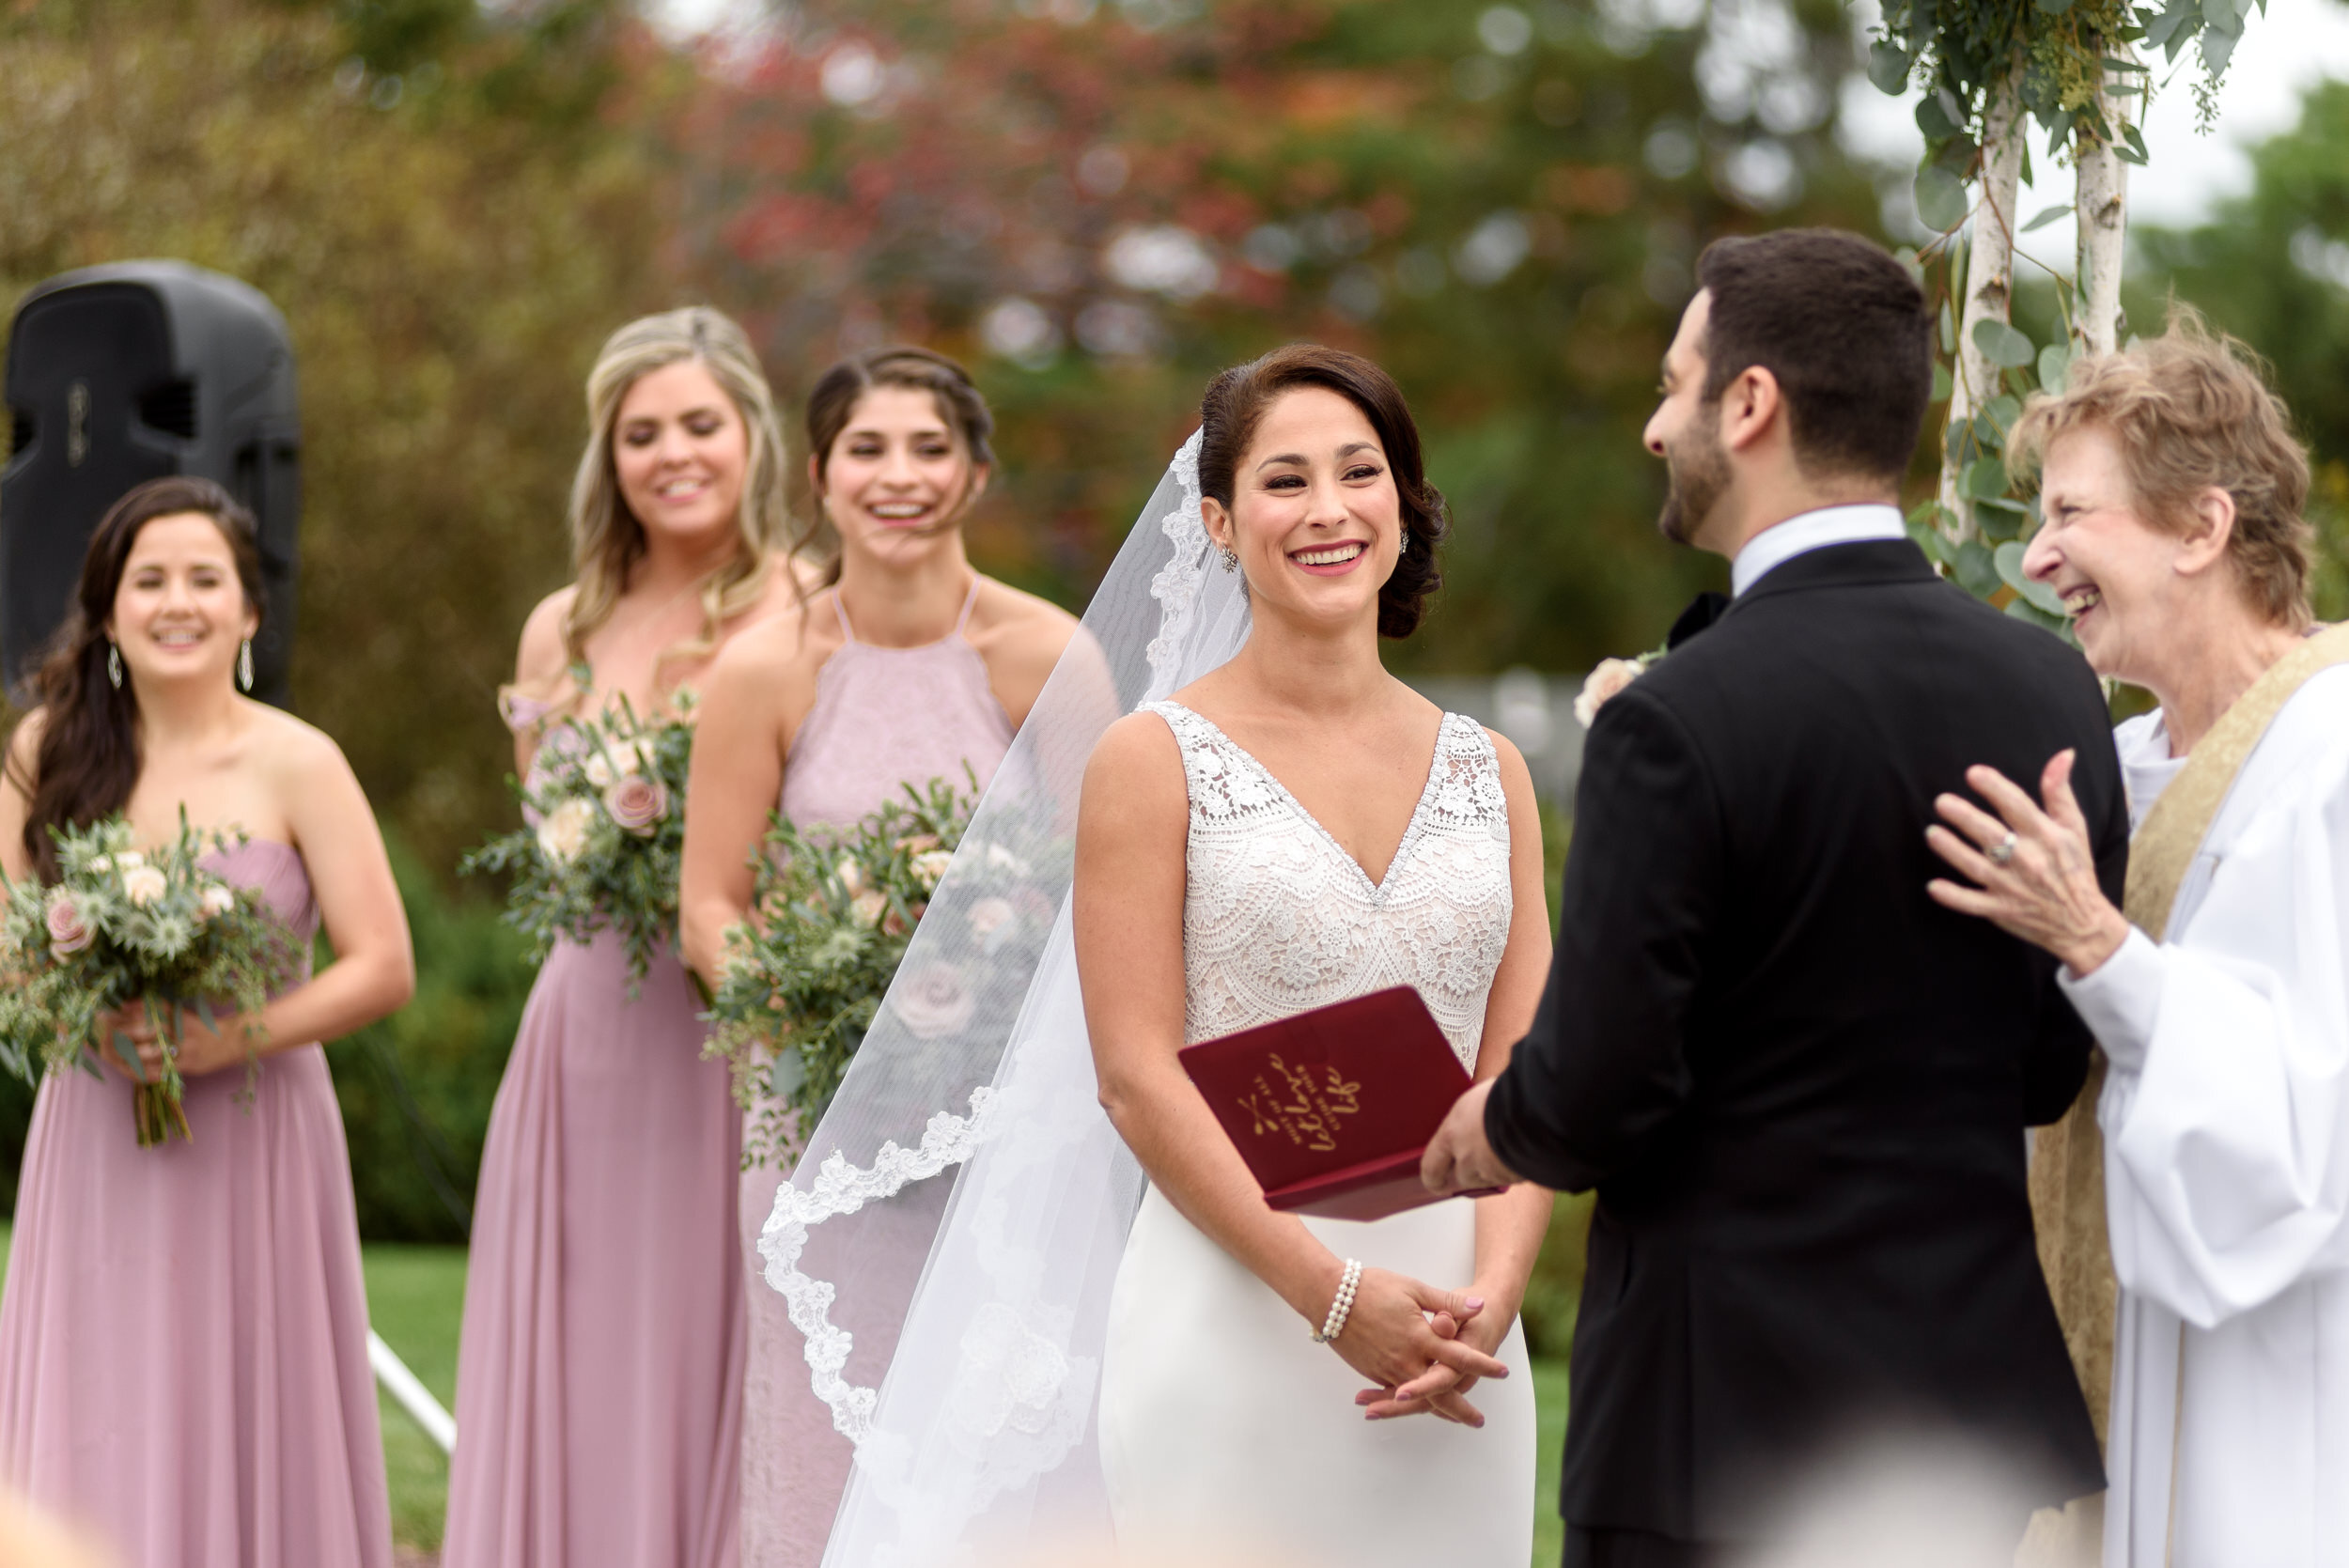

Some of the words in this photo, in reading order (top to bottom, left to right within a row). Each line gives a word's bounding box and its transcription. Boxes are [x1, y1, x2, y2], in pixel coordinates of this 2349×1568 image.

[1254, 1075, 1271, 1095] ALL
[1268, 1052, 1312, 1113] love
[1295, 1064, 1318, 1094] YOUR
[1326, 1065, 1361, 1113] life
[1269, 1100, 1282, 1114] OF
[1298, 1113, 1336, 1151] let
